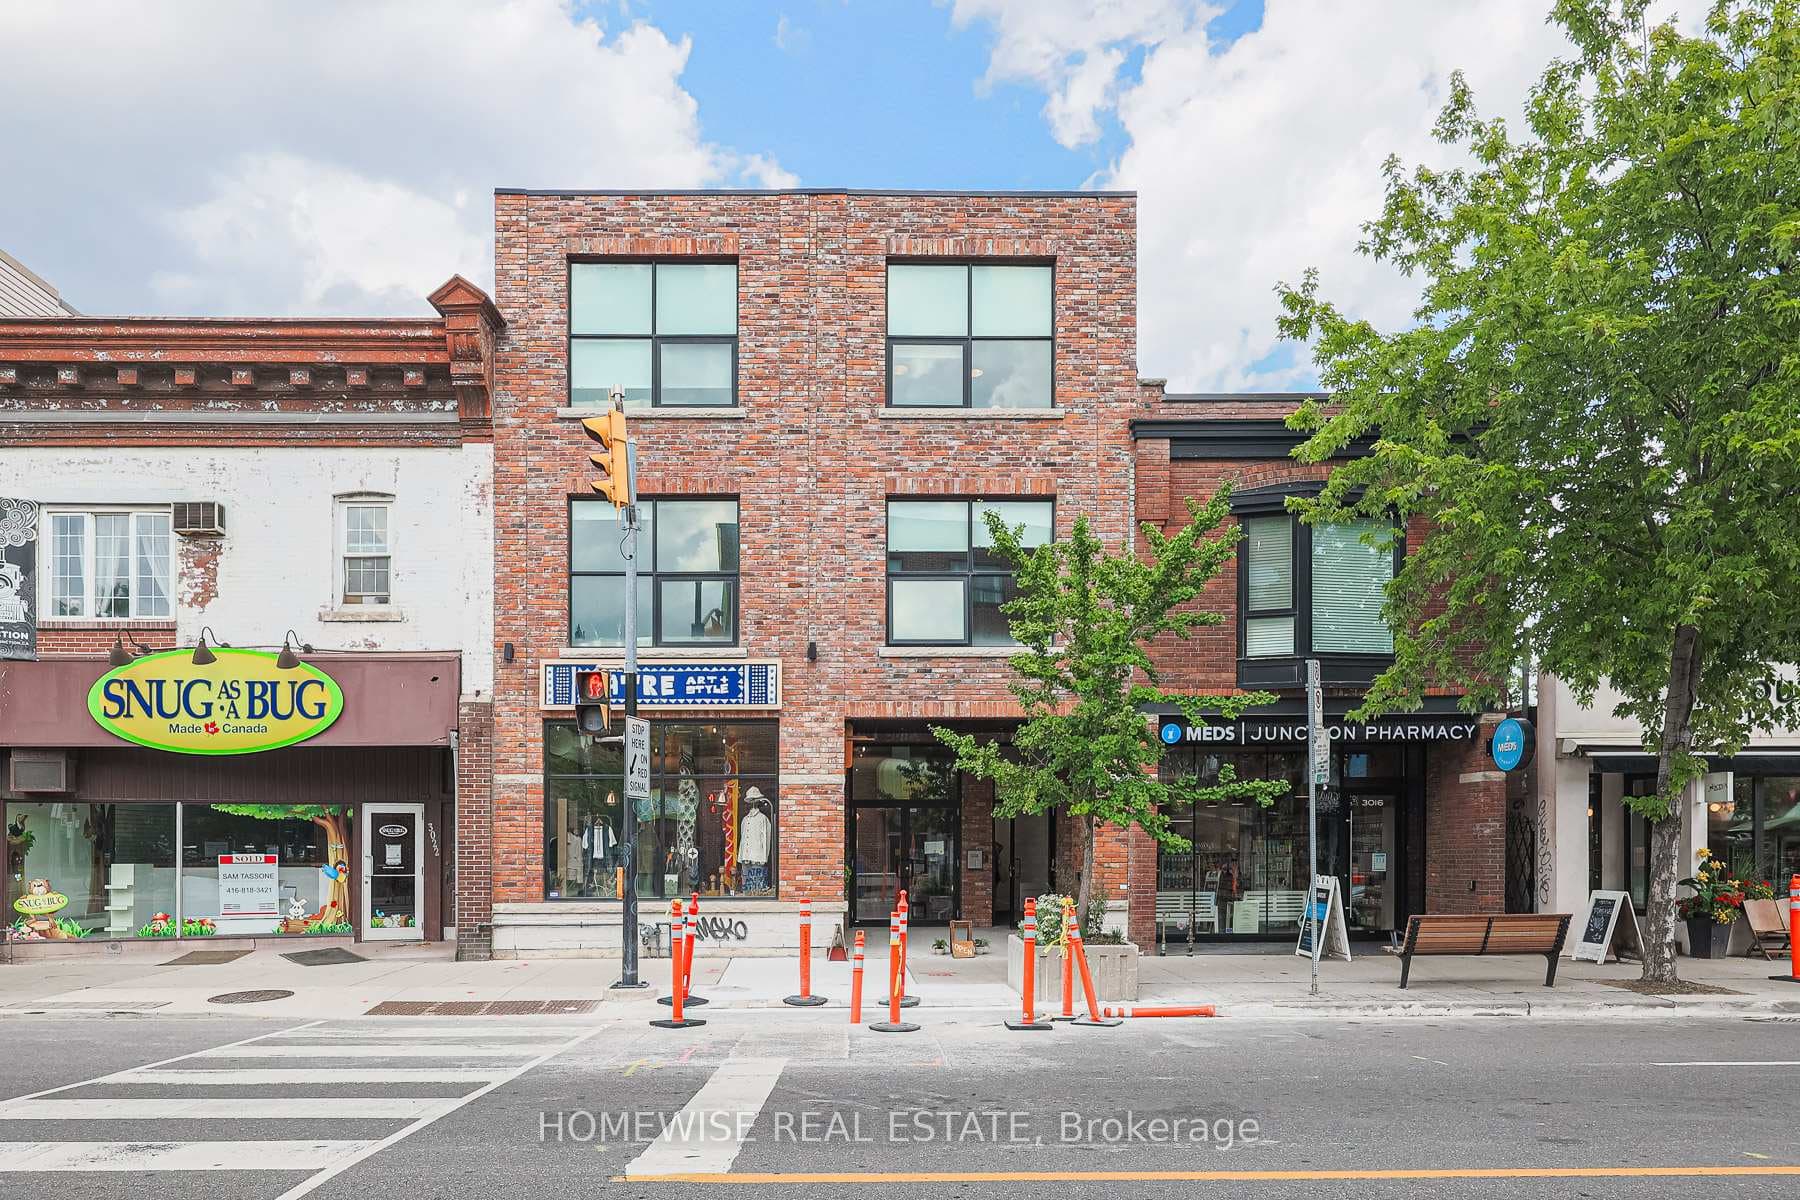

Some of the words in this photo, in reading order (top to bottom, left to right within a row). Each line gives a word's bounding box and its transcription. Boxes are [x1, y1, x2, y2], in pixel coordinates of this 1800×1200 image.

[685, 675, 718, 685] ART
[685, 684, 729, 694] STYLE
[103, 678, 214, 720] SNUG
[217, 680, 241, 700] AS
[245, 679, 327, 720] BUG
[168, 723, 202, 734] Made
[222, 723, 268, 734] Canada
[631, 723, 645, 735] STOP
[1186, 726, 1235, 741] MEDS
[1250, 725, 1356, 741] JUNCON
[1365, 725, 1476, 740] PHARMACY
[631, 738, 645, 750] HERE
[1497, 742, 1517, 753] MEDS
[640, 754, 648, 765] ON
[637, 767, 648, 779] RED
[629, 781, 648, 793] SIGNAL
[1361, 799, 1384, 807] 3016
[427, 822, 440, 857] 3022
[235, 855, 263, 863] SOLD
[240, 872, 275, 880] TASSONE
[954, 944, 973, 956] OPEN
